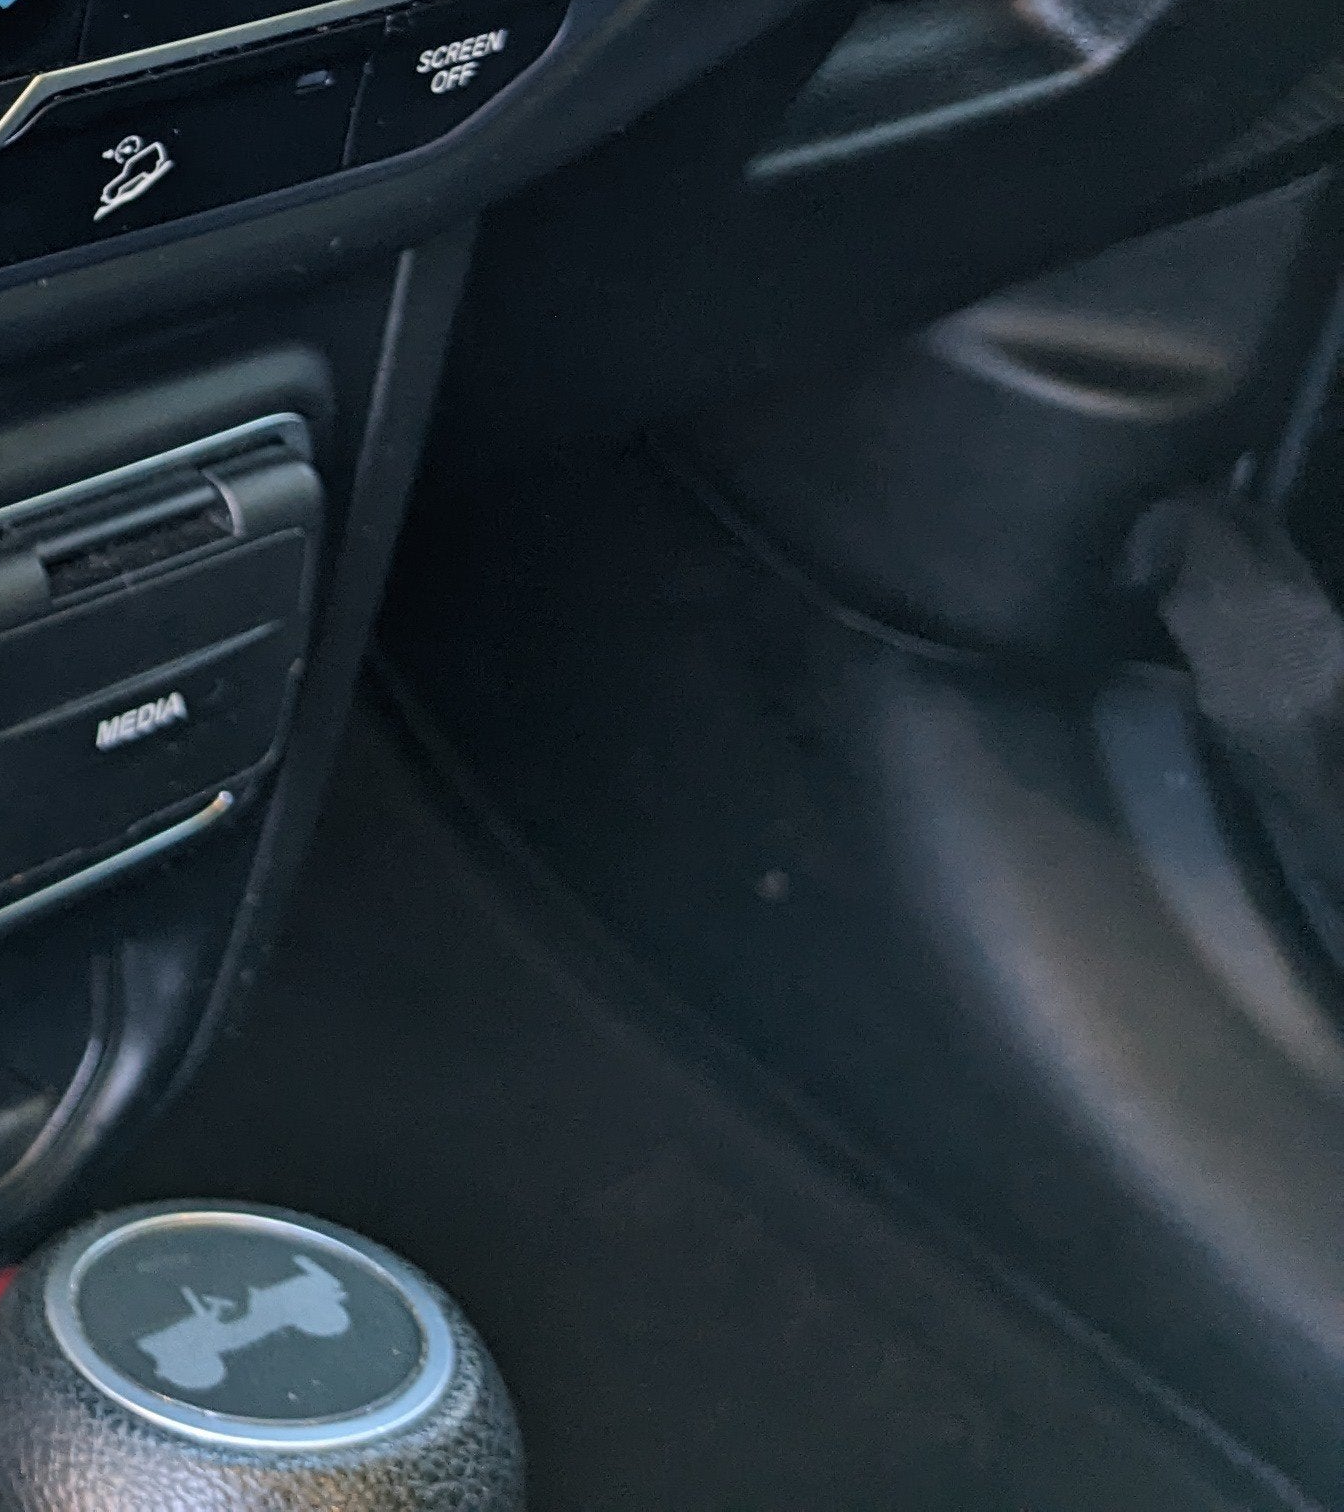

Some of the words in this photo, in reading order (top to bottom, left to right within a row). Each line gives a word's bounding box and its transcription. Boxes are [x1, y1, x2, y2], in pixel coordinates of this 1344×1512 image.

[416, 29, 508, 74] SCREEN
[431, 61, 480, 93] OFF
[96, 692, 188, 751] MEDIA
